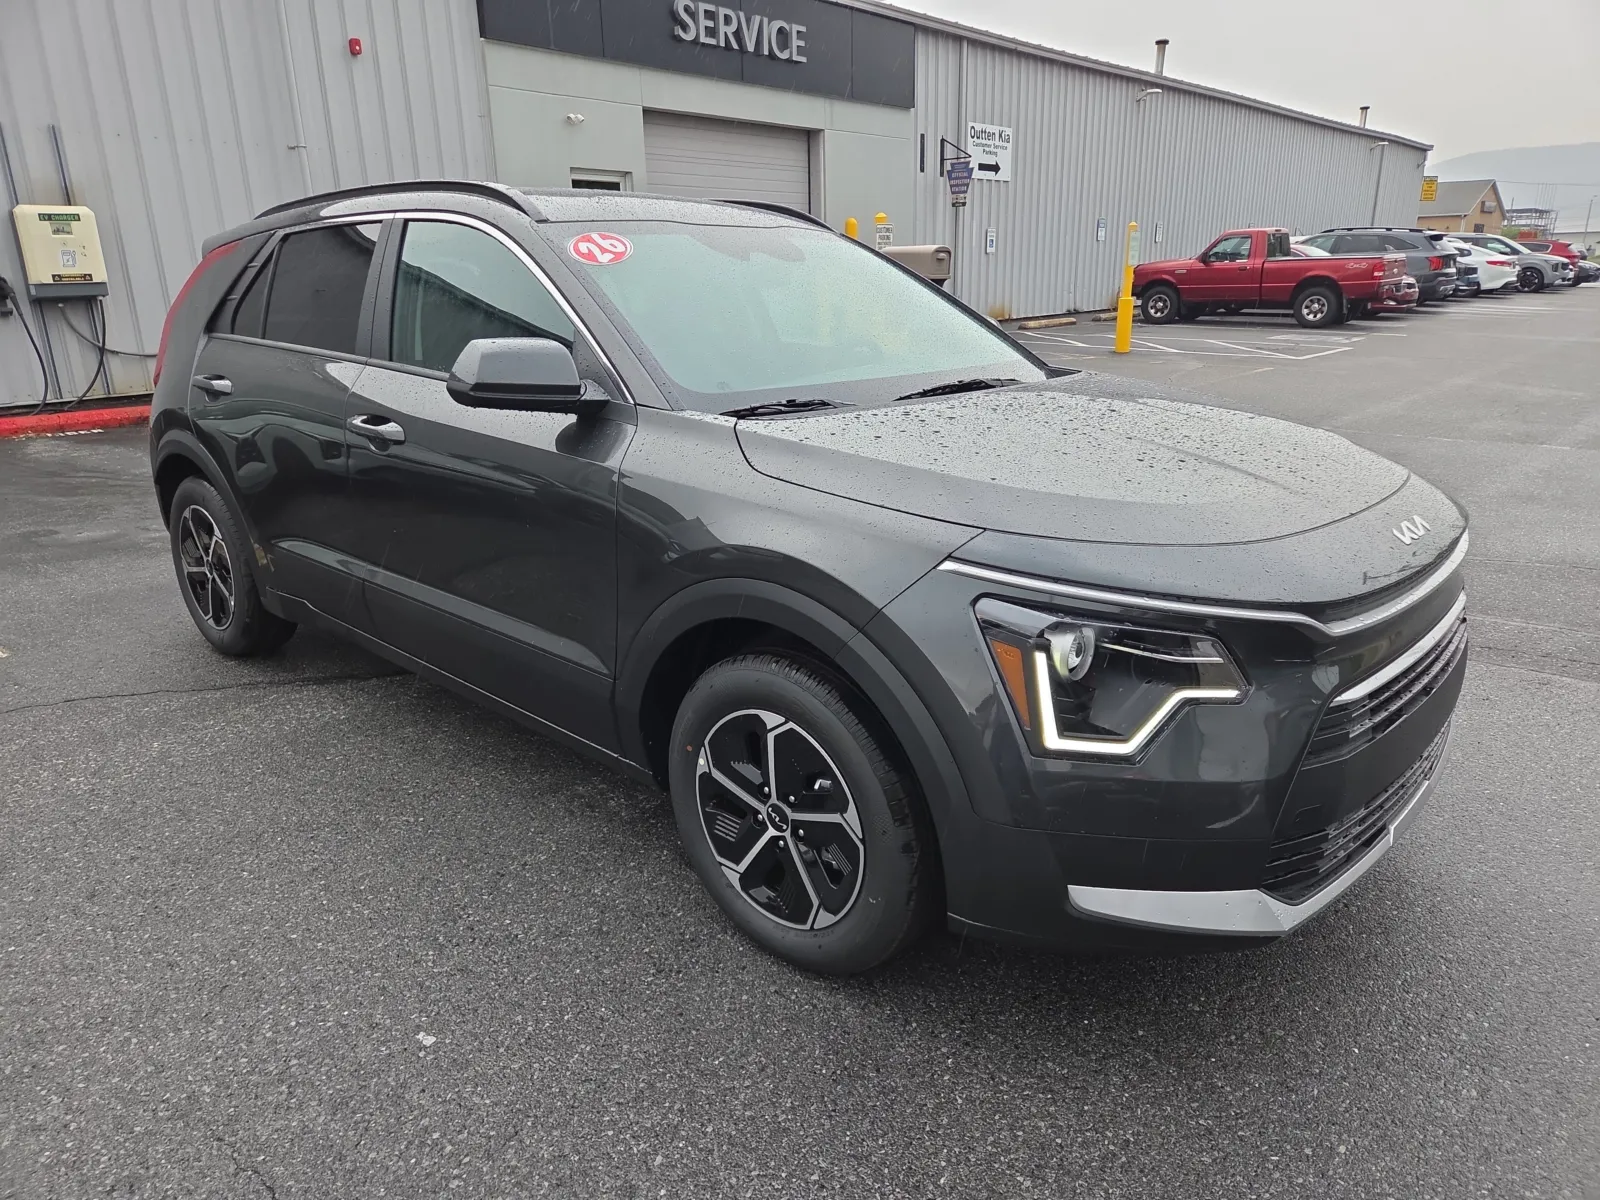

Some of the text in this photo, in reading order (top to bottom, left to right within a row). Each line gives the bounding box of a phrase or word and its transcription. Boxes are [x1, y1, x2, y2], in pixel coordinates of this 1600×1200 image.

[673, 0, 807, 63] SERVICE
[969, 125, 1011, 144] Outten Kia
[972, 140, 1008, 151] Customer Service
[982, 148, 998, 158] Parking
[578, 233, 626, 263] 26
